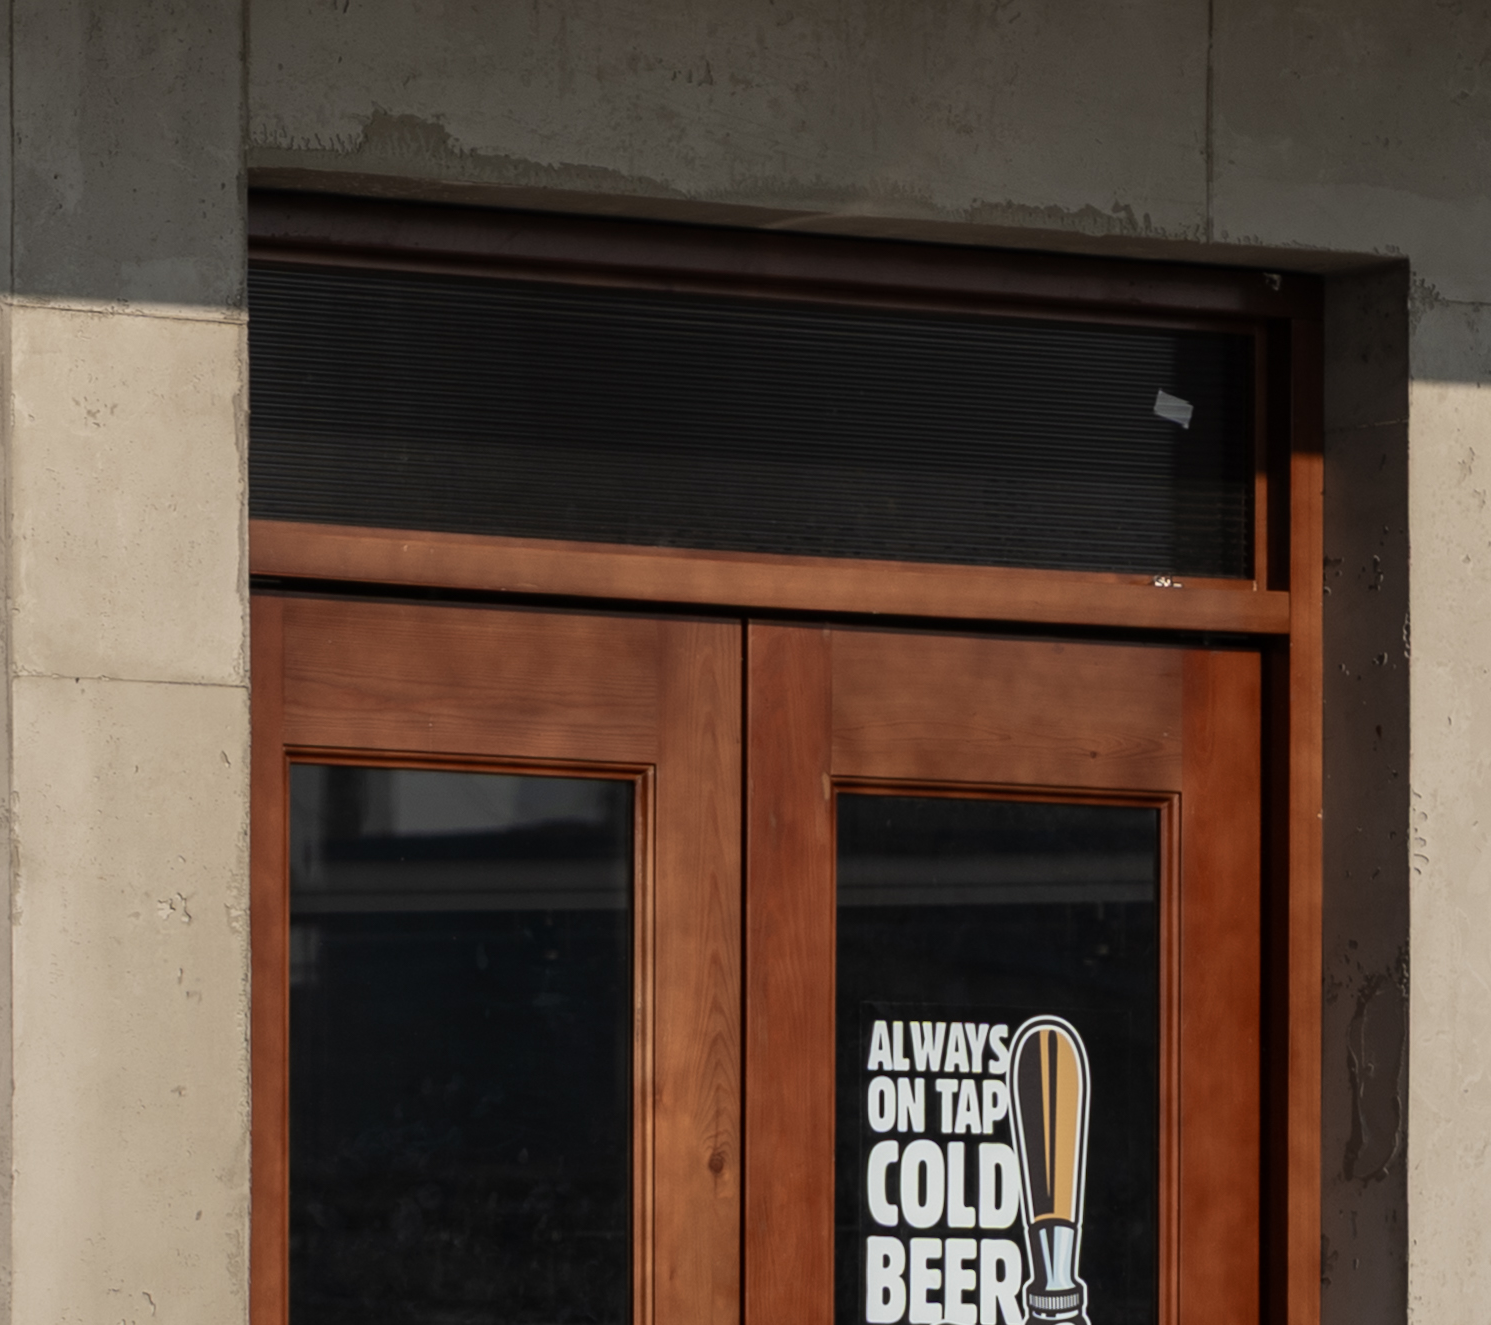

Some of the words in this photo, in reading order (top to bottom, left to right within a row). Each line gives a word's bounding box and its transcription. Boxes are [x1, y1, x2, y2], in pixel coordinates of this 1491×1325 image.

[867, 1020, 1010, 1074] ALWAYS
[867, 1077, 925, 1133] ON
[936, 1079, 1009, 1134] TAP
[866, 1139, 1021, 1230] COLD
